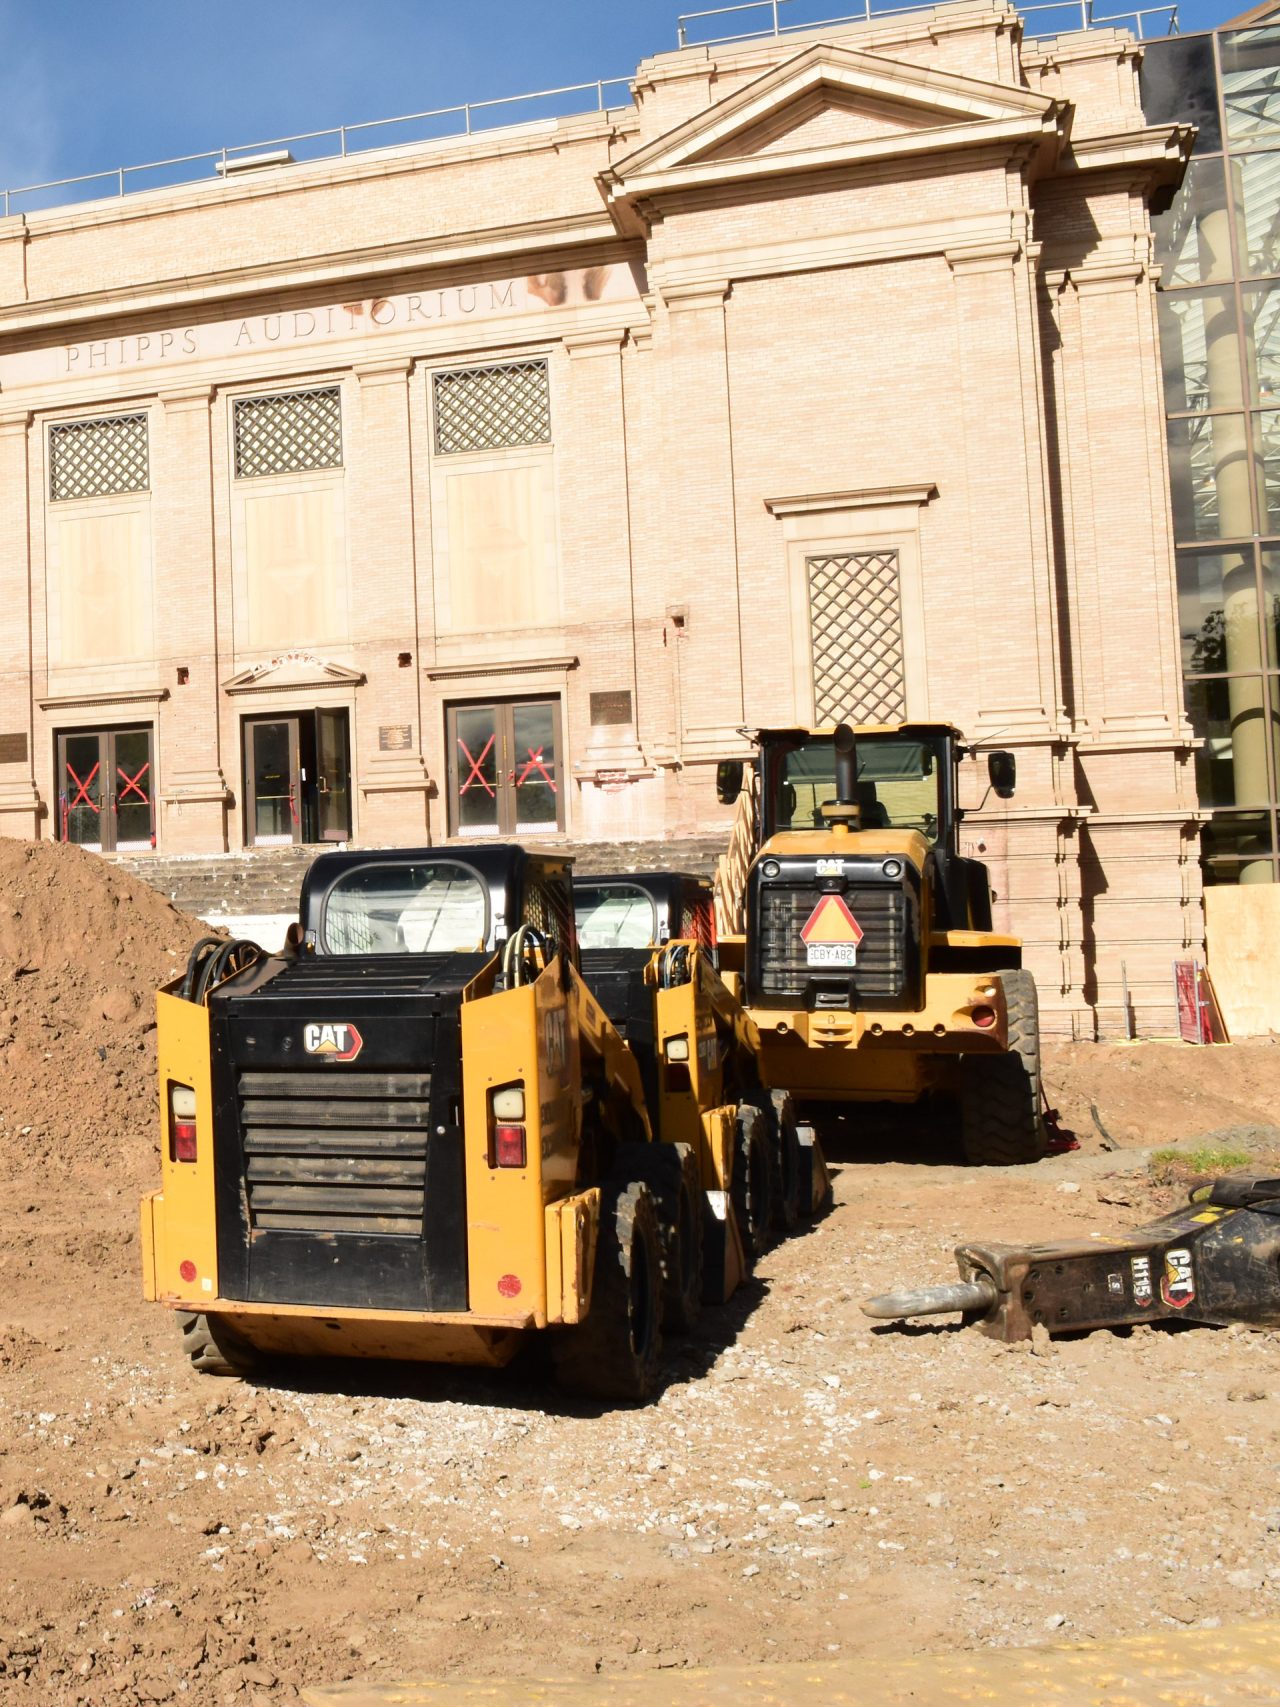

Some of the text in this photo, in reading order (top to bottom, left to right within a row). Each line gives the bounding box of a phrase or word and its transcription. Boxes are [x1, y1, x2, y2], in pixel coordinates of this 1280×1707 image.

[65, 281, 518, 372] PHIPPS AUDITORIUM
[816, 859, 845, 874] CAT
[305, 1024, 348, 1052] CAT
[1132, 1257, 1151, 1297] H115
[1166, 1249, 1193, 1293] CAT
